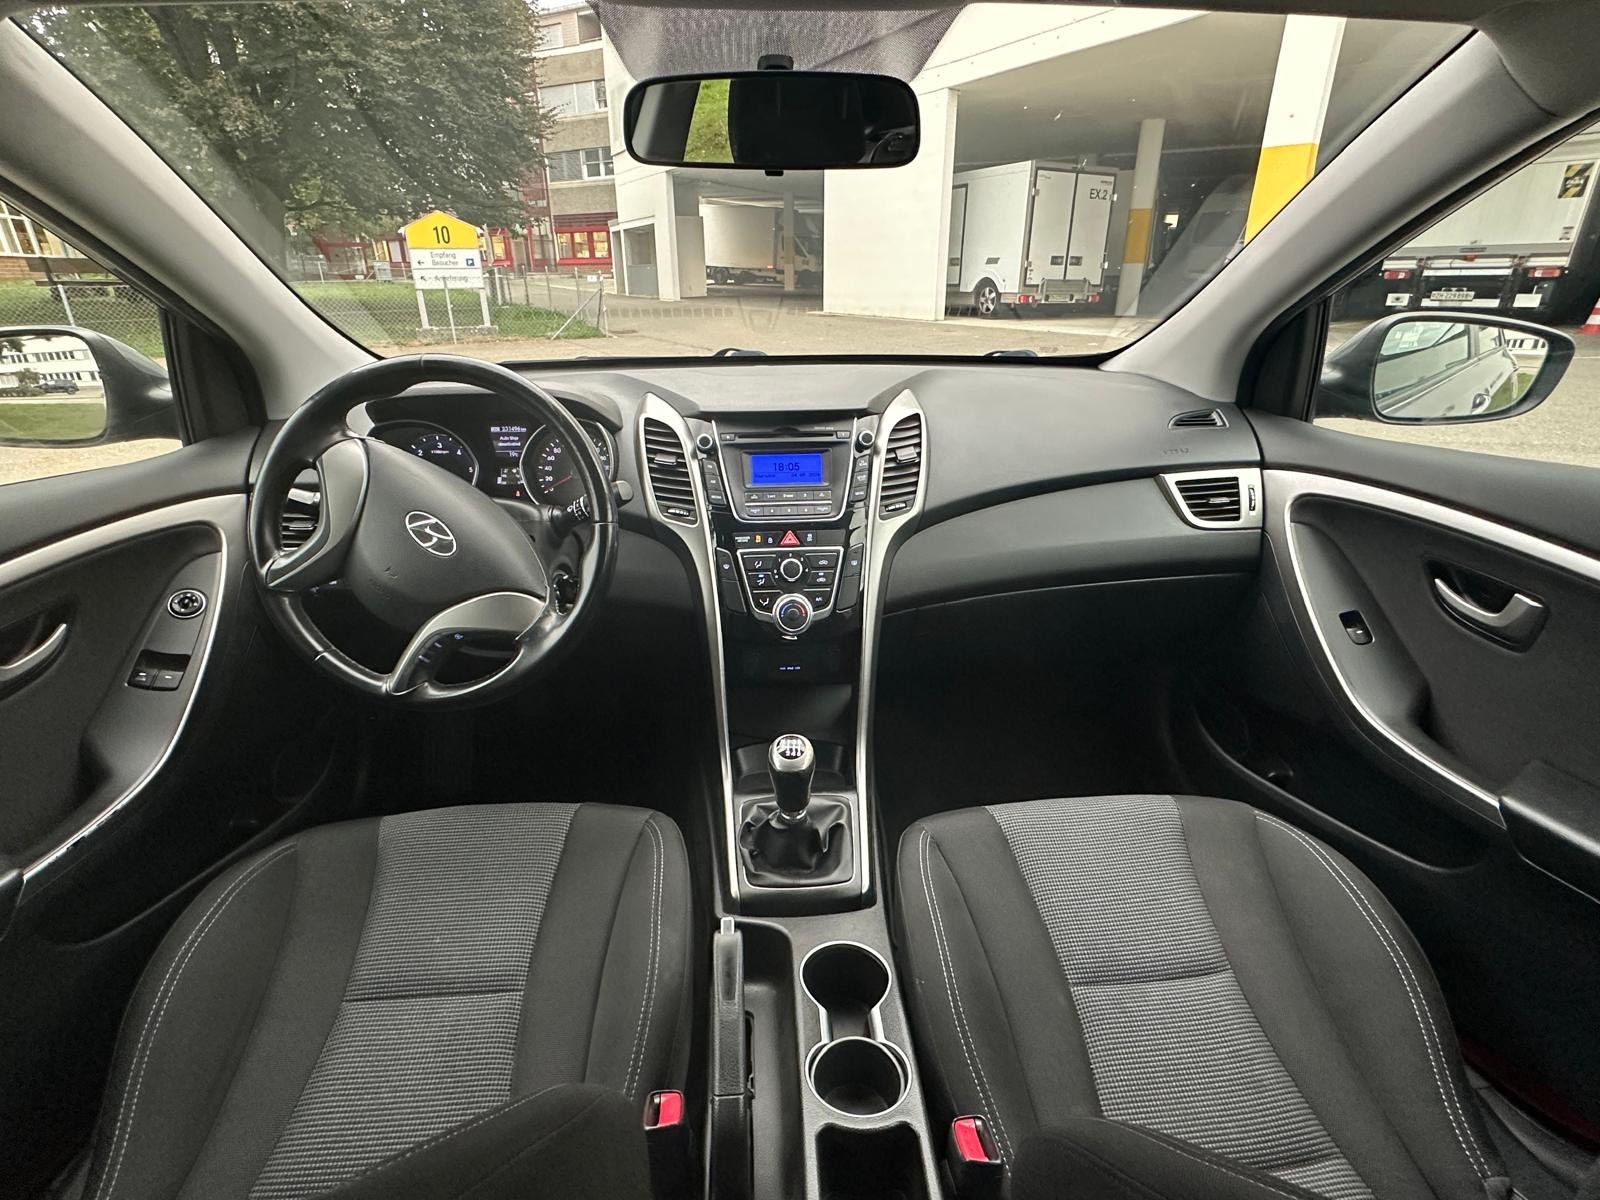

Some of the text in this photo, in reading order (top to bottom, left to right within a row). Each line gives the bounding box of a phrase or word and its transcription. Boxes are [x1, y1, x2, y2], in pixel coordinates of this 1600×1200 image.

[1089, 188, 1108, 200] EX.2
[432, 225, 451, 244] 10
[430, 251, 457, 259] Empfang
[773, 462, 800, 472] 18:05
